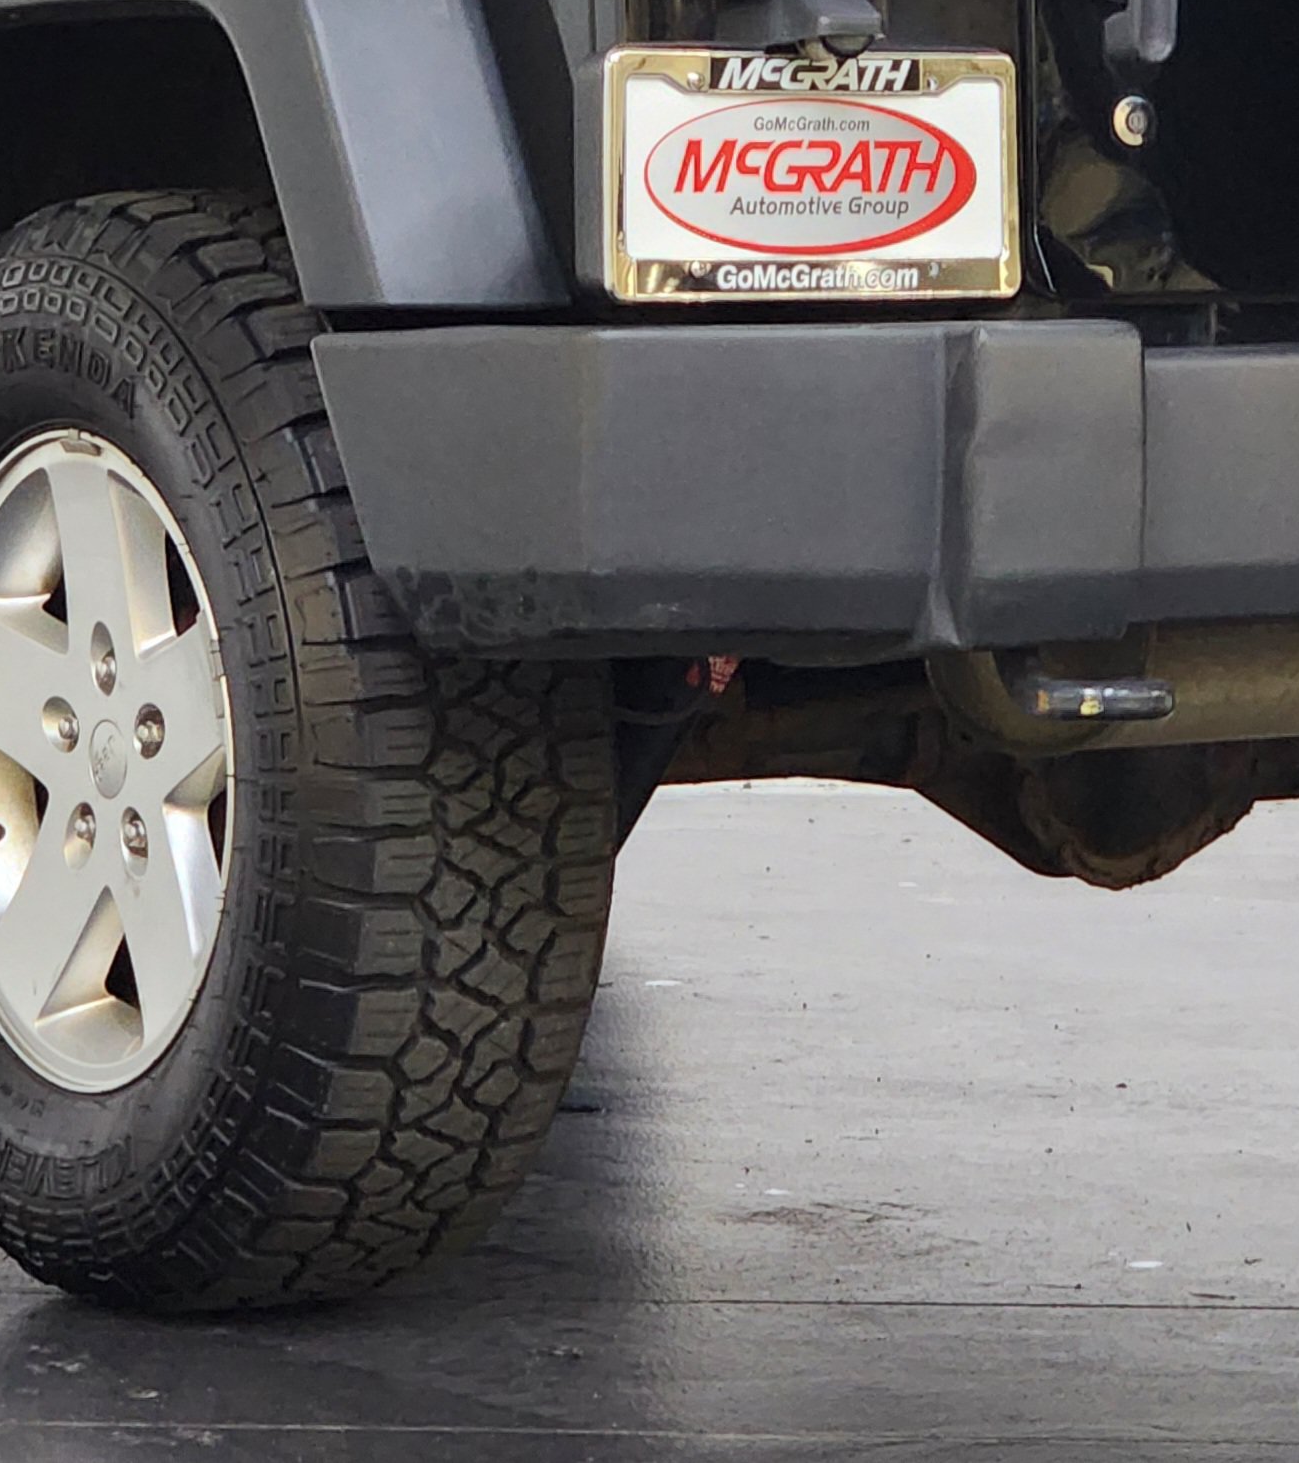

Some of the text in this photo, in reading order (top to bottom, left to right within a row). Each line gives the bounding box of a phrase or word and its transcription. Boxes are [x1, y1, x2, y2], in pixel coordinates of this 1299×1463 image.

[753, 116, 871, 133] GoMcGrath.com
[729, 196, 910, 220] Automotive Group
[717, 265, 919, 289] GoMcGrath.com
[0, 326, 137, 420] KENDA
